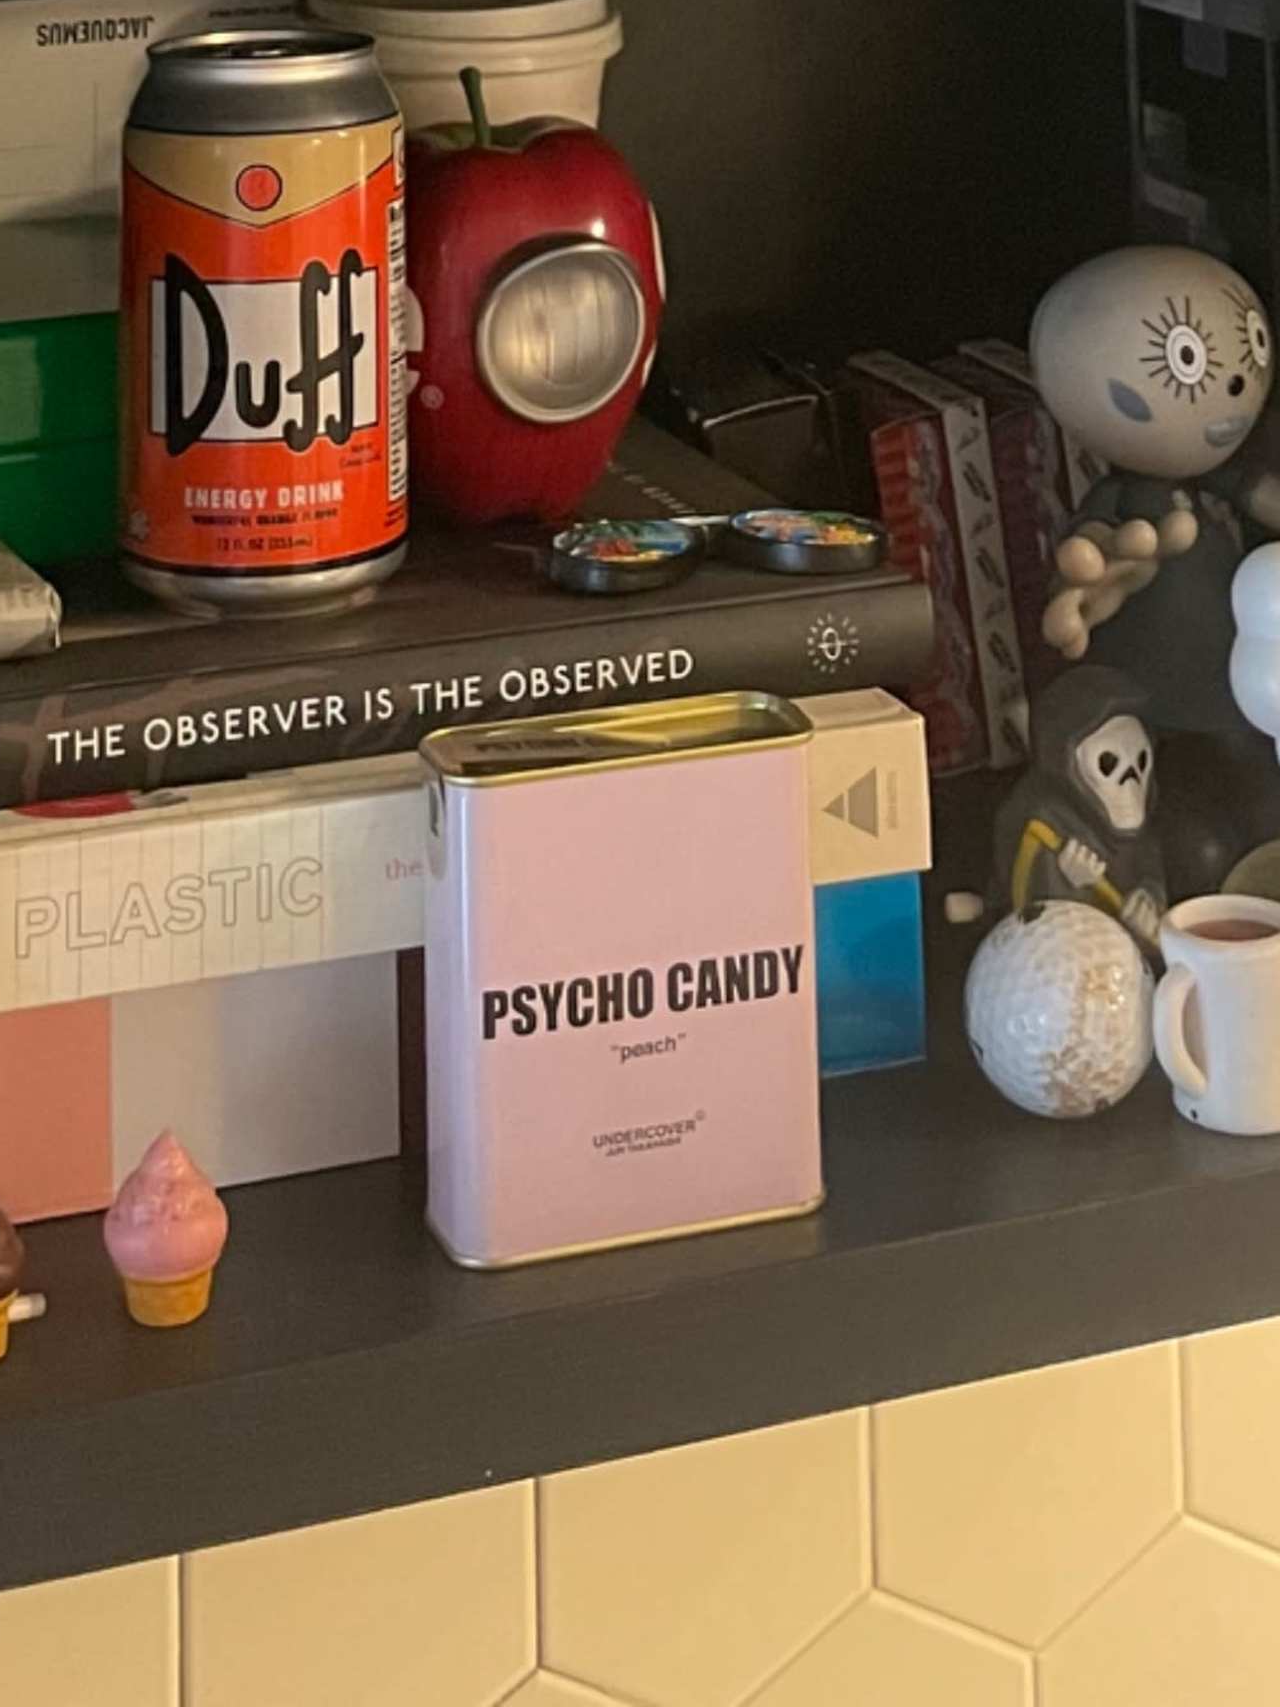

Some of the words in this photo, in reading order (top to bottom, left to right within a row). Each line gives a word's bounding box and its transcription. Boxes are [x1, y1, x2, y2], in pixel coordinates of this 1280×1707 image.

[36, 15, 154, 47] JACQUEMUS
[164, 248, 364, 456] Duff
[184, 486, 268, 509] ENERGY
[277, 480, 345, 508] DRINK
[47, 723, 125, 764] THE
[143, 694, 347, 750] OBSERVER
[363, 688, 395, 723] IS
[411, 674, 484, 715] THE
[498, 648, 693, 704] OBSERVED
[15, 856, 323, 959] PLASTIC
[385, 855, 424, 881] the
[482, 967, 654, 1040] PSYCHO
[667, 944, 804, 1013] CANDY
